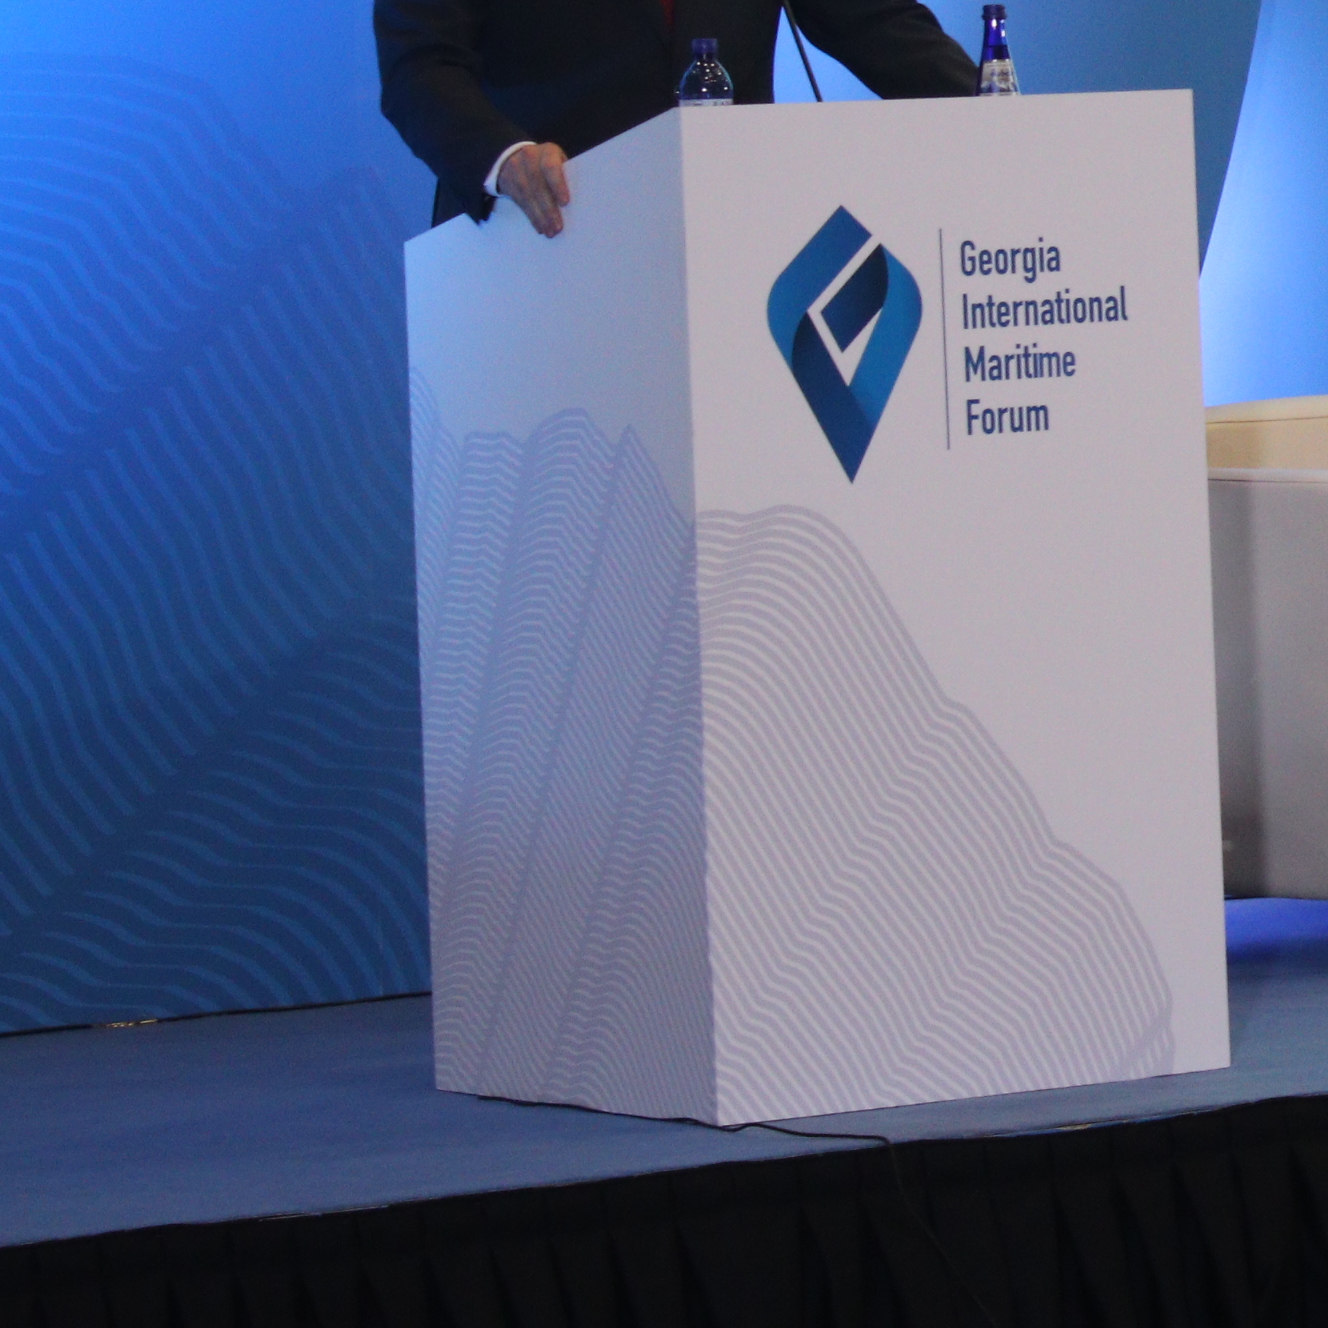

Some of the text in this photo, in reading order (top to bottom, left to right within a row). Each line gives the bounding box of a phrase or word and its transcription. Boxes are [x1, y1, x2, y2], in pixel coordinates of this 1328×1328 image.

[960, 236, 1061, 284] Georgia
[962, 285, 1129, 330] International
[963, 342, 1077, 383] Maritime
[966, 398, 1050, 436] Forum
